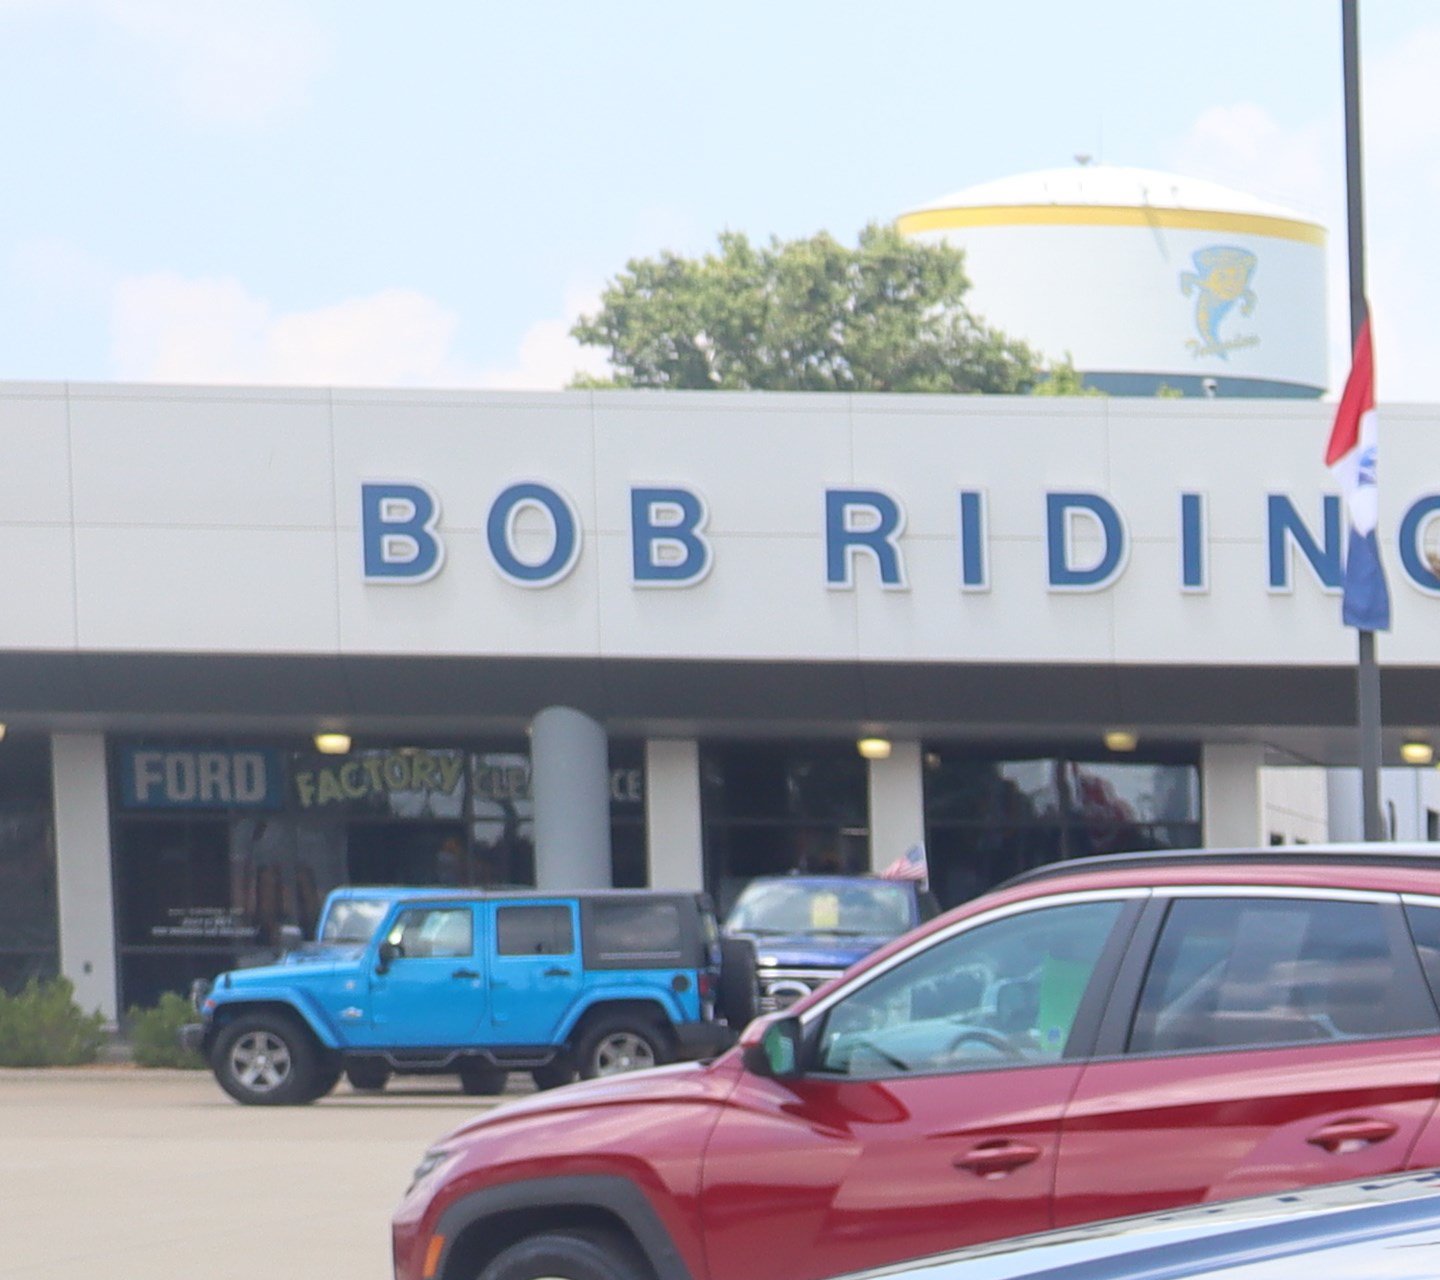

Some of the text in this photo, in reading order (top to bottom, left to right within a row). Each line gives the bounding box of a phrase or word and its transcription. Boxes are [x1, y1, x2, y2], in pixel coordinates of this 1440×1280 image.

[361, 481, 712, 589] BOB
[134, 752, 267, 803] FORD
[295, 752, 463, 808] FACTORY
